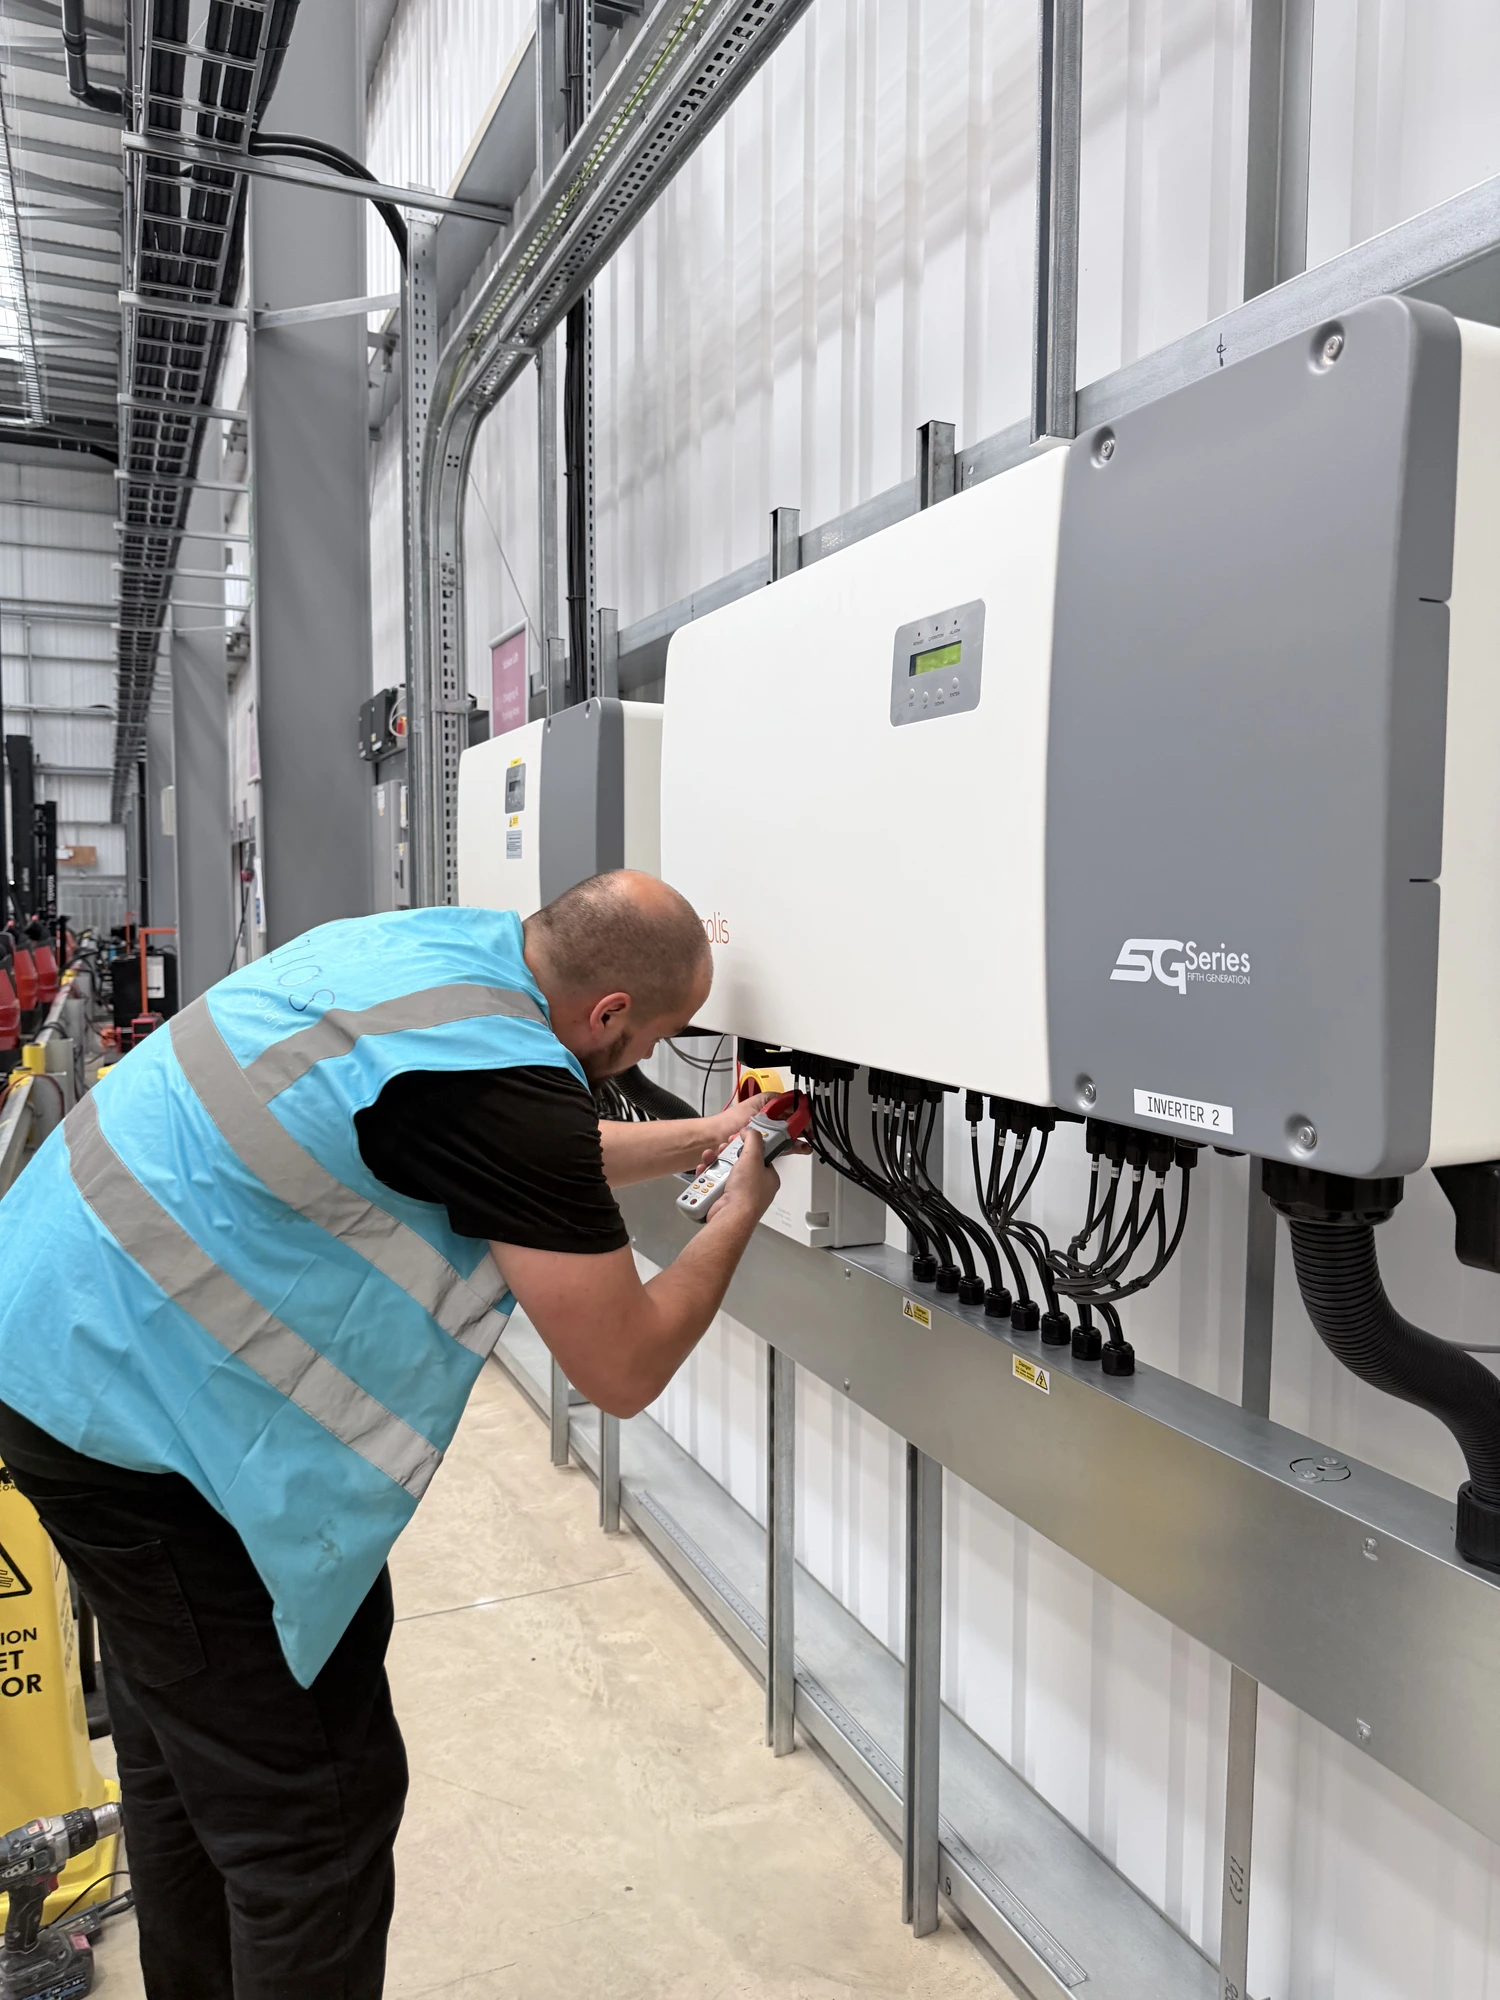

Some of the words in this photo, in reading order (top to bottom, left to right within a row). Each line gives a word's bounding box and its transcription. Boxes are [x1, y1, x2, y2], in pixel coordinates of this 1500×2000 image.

[1185, 940, 1251, 973] Series
[1187, 972, 1205, 983] FIFTH
[1205, 974, 1251, 986] GENERATION
[1147, 1096, 1205, 1124] INVERTER
[1212, 1109, 1220, 1127] 2
[0, 1627, 37, 1646] ION
[0, 1649, 24, 1672] ET
[1, 1673, 43, 1698] OR
